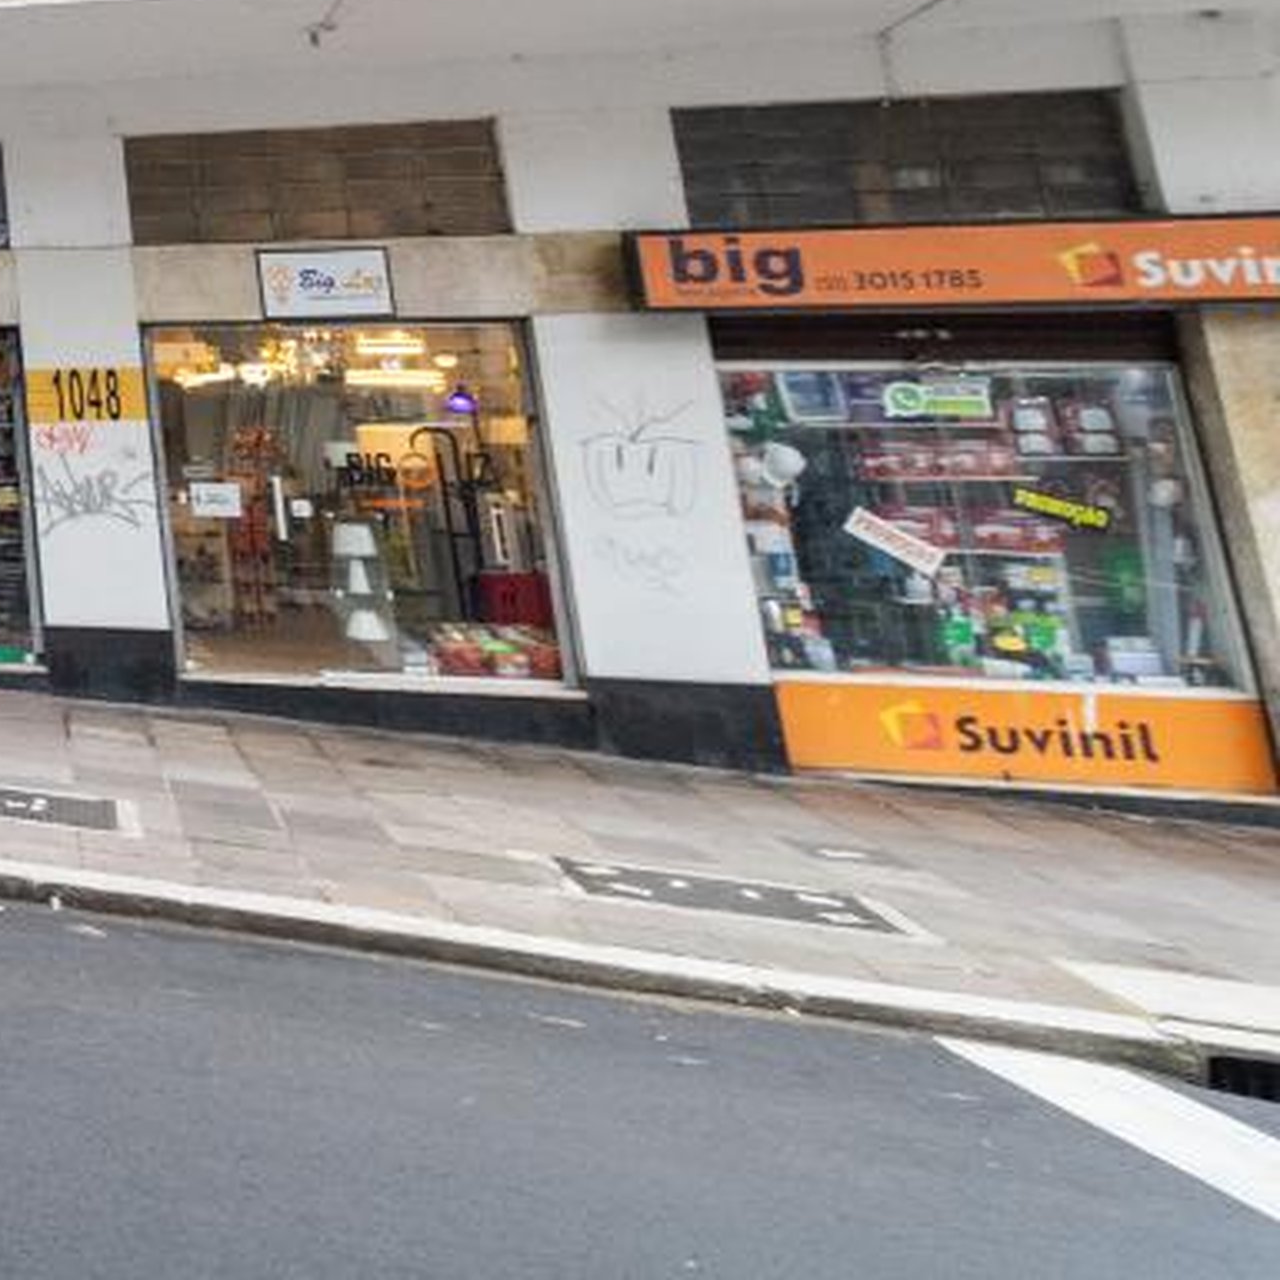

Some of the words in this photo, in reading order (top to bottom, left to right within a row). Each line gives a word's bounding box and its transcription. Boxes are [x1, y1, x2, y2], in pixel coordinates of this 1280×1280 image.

[298, 268, 336, 294] Big
[669, 237, 805, 295] big
[855, 270, 915, 290] 3015
[925, 268, 983, 289] 1785
[52, 368, 122, 420] 1048
[955, 715, 1160, 763] Suvinil
